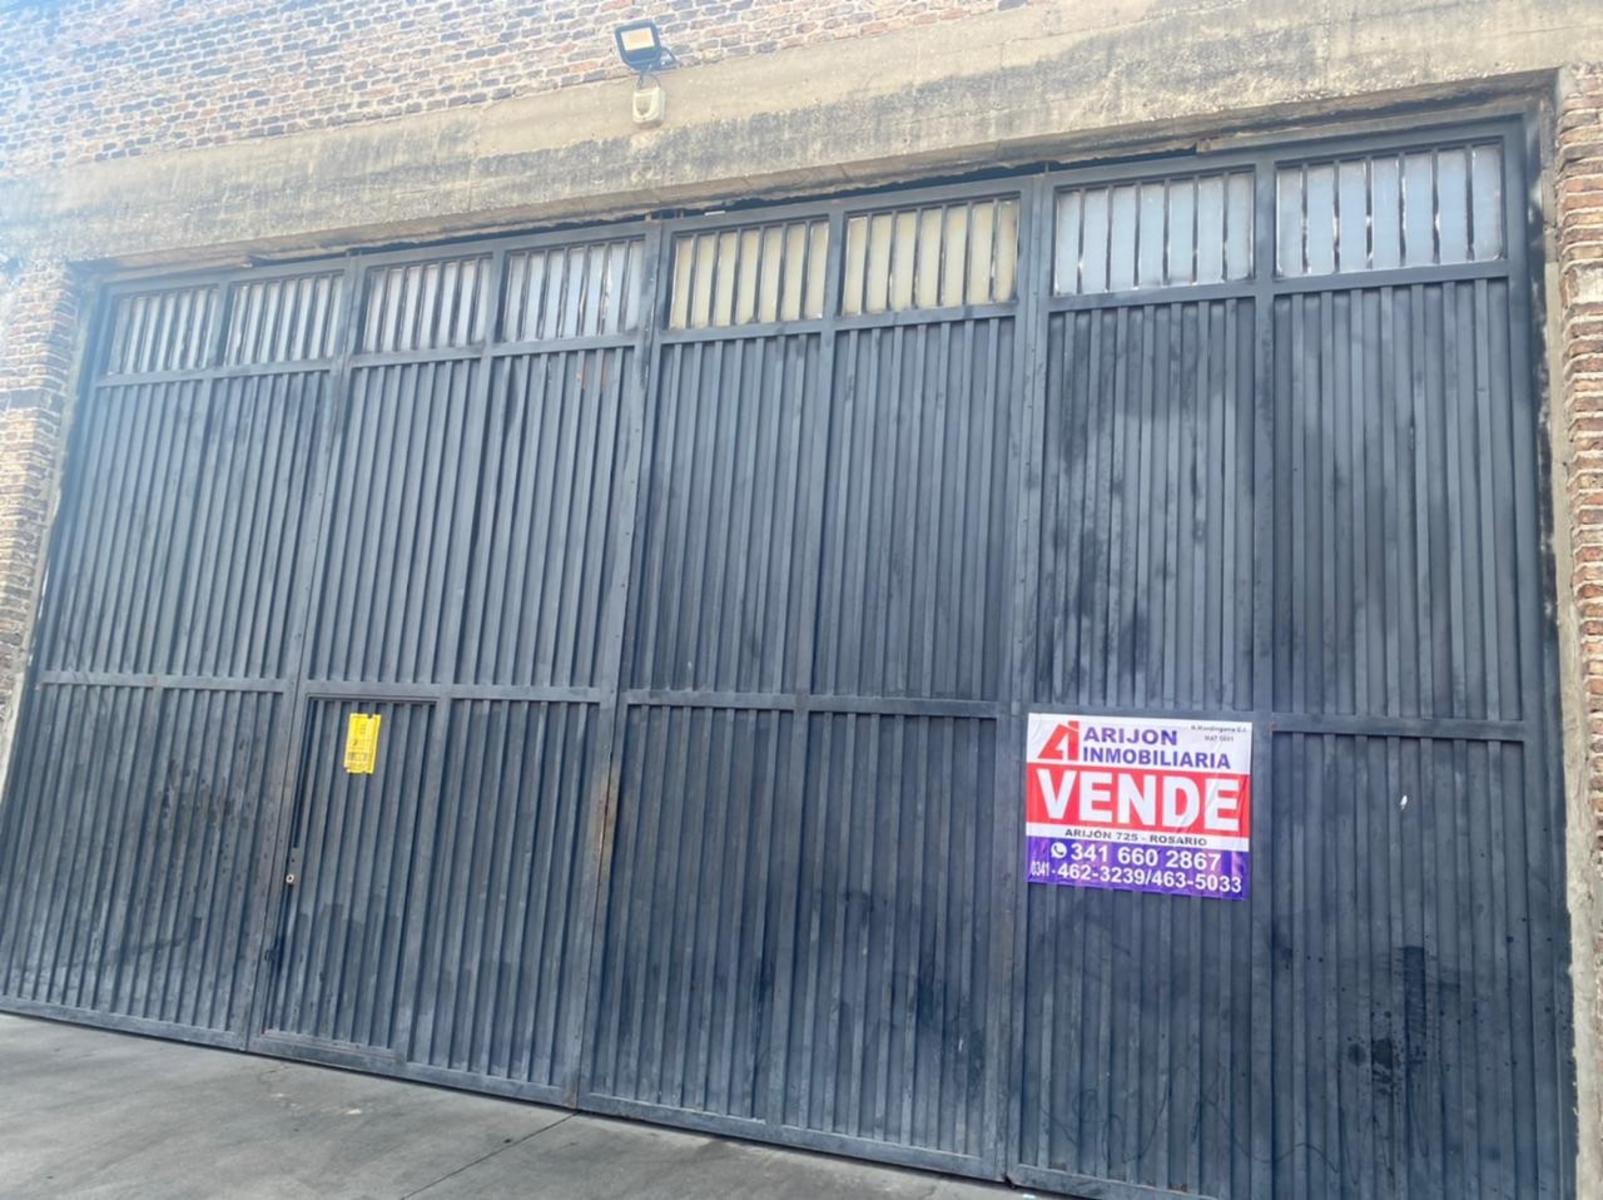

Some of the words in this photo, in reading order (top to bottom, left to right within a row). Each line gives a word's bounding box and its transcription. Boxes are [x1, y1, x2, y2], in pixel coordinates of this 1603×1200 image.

[1083, 727, 1178, 746] ARIJON
[1083, 748, 1231, 769] INMOBILIARIA
[1037, 769, 1240, 832] VENDE
[1116, 832, 1138, 842] 725
[1149, 835, 1207, 846] ROSARIO
[1071, 842, 1108, 863] 341
[1117, 847, 1158, 867] 660
[1166, 850, 1221, 870] 2867
[1057, 863, 1242, 893] 462-3239/463-5033
